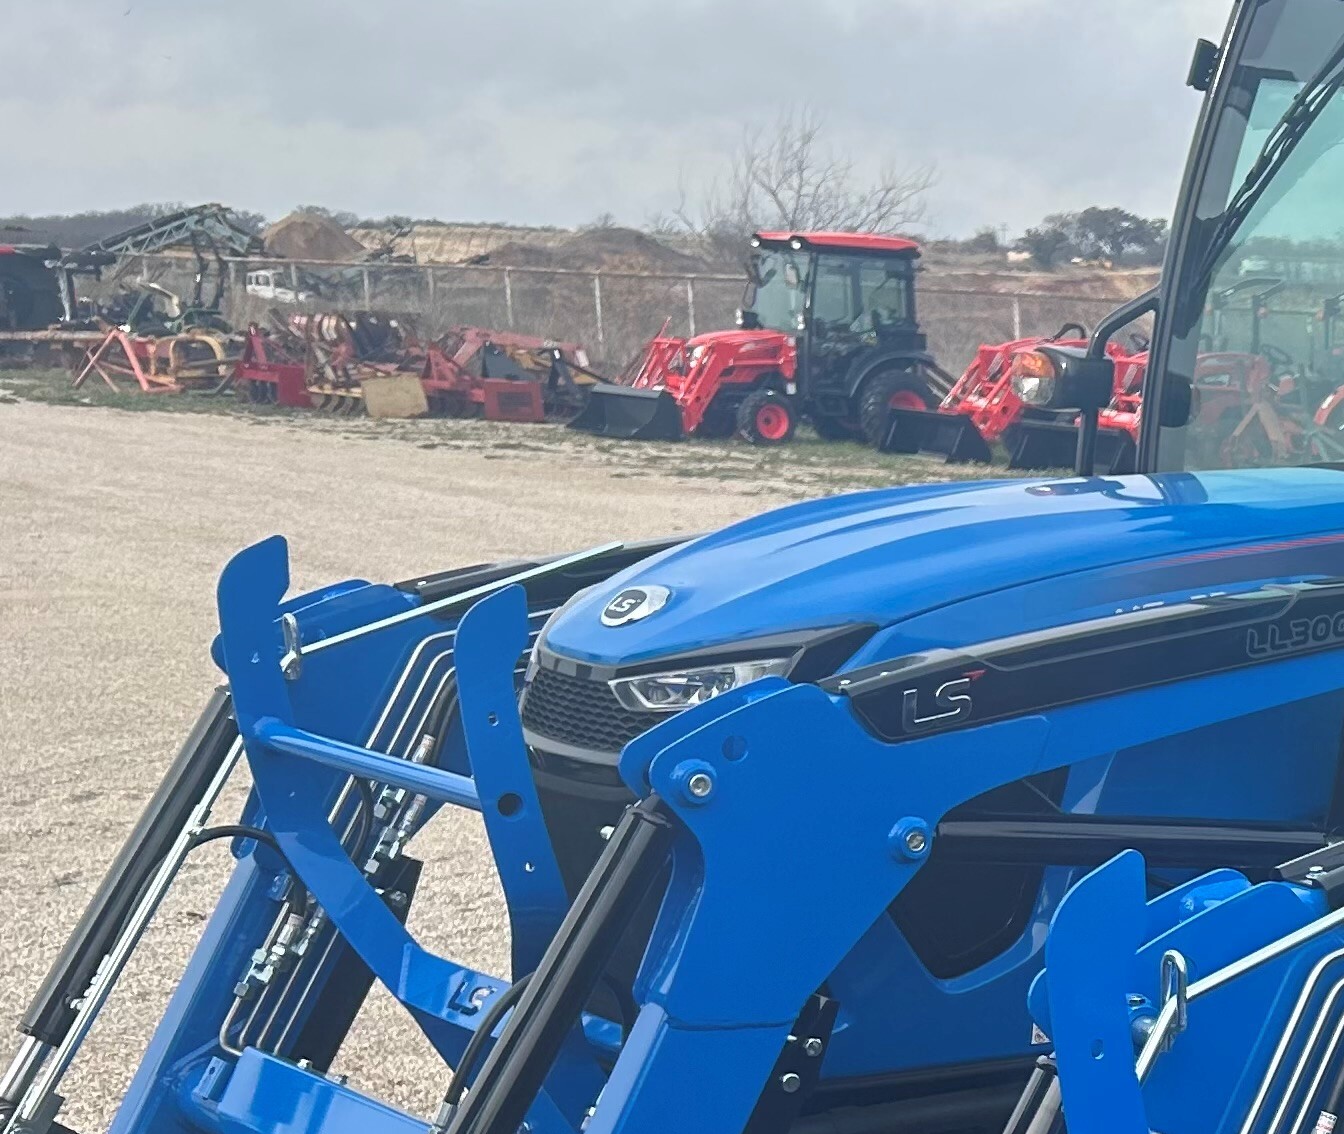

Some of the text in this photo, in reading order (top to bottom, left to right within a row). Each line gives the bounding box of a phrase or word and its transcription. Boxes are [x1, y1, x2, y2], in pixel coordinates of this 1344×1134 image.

[609, 597, 638, 612] LS
[902, 678, 972, 733] LS
[447, 981, 492, 1016] LS
